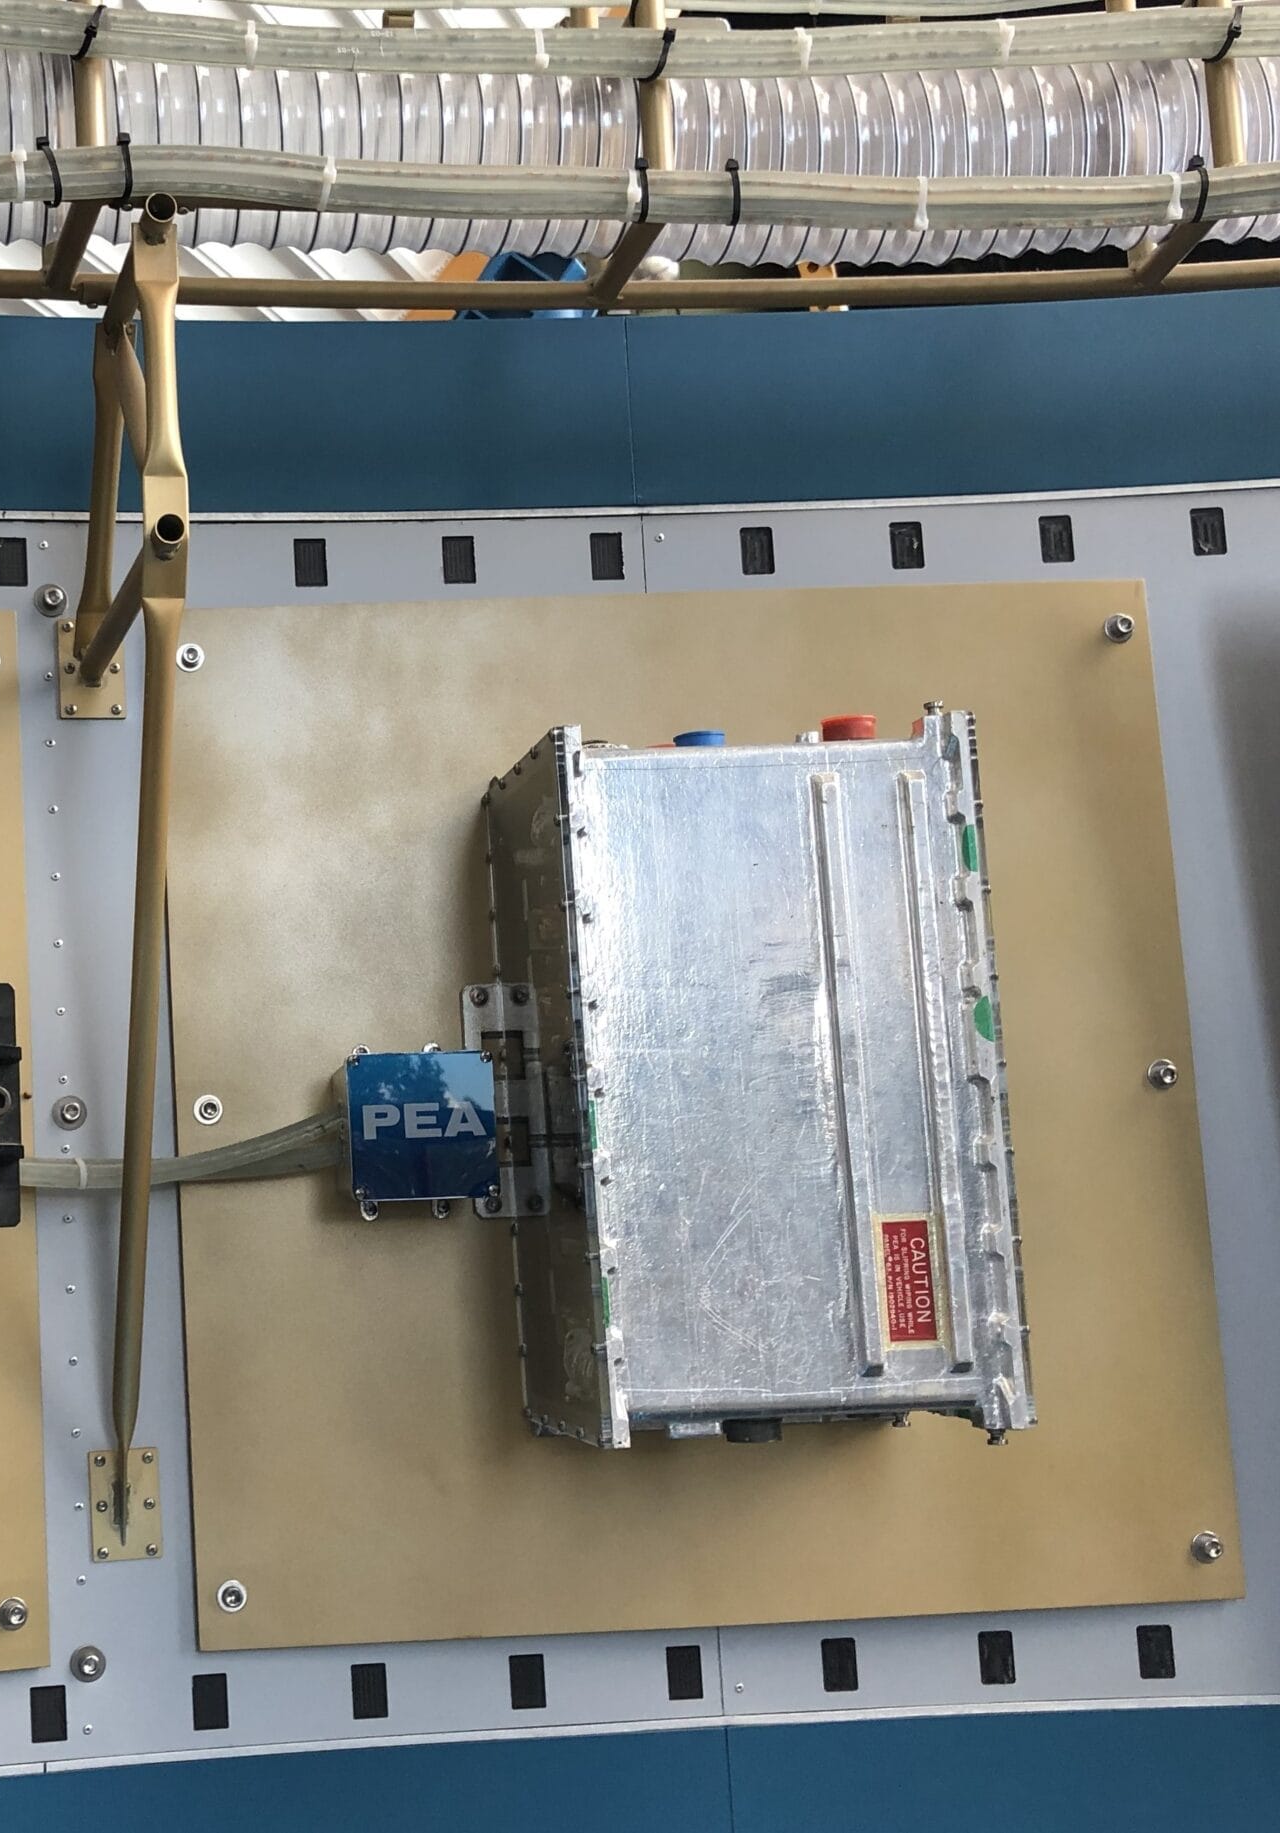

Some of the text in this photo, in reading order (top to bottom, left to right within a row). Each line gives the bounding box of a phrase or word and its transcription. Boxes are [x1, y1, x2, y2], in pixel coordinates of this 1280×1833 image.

[362, 1101, 488, 1140] PEA
[894, 1264, 901, 1272] IN
[910, 1237, 932, 1323] CAUTION
[904, 1283, 913, 1309] WIPING
[907, 1312, 915, 1334] WHILE
